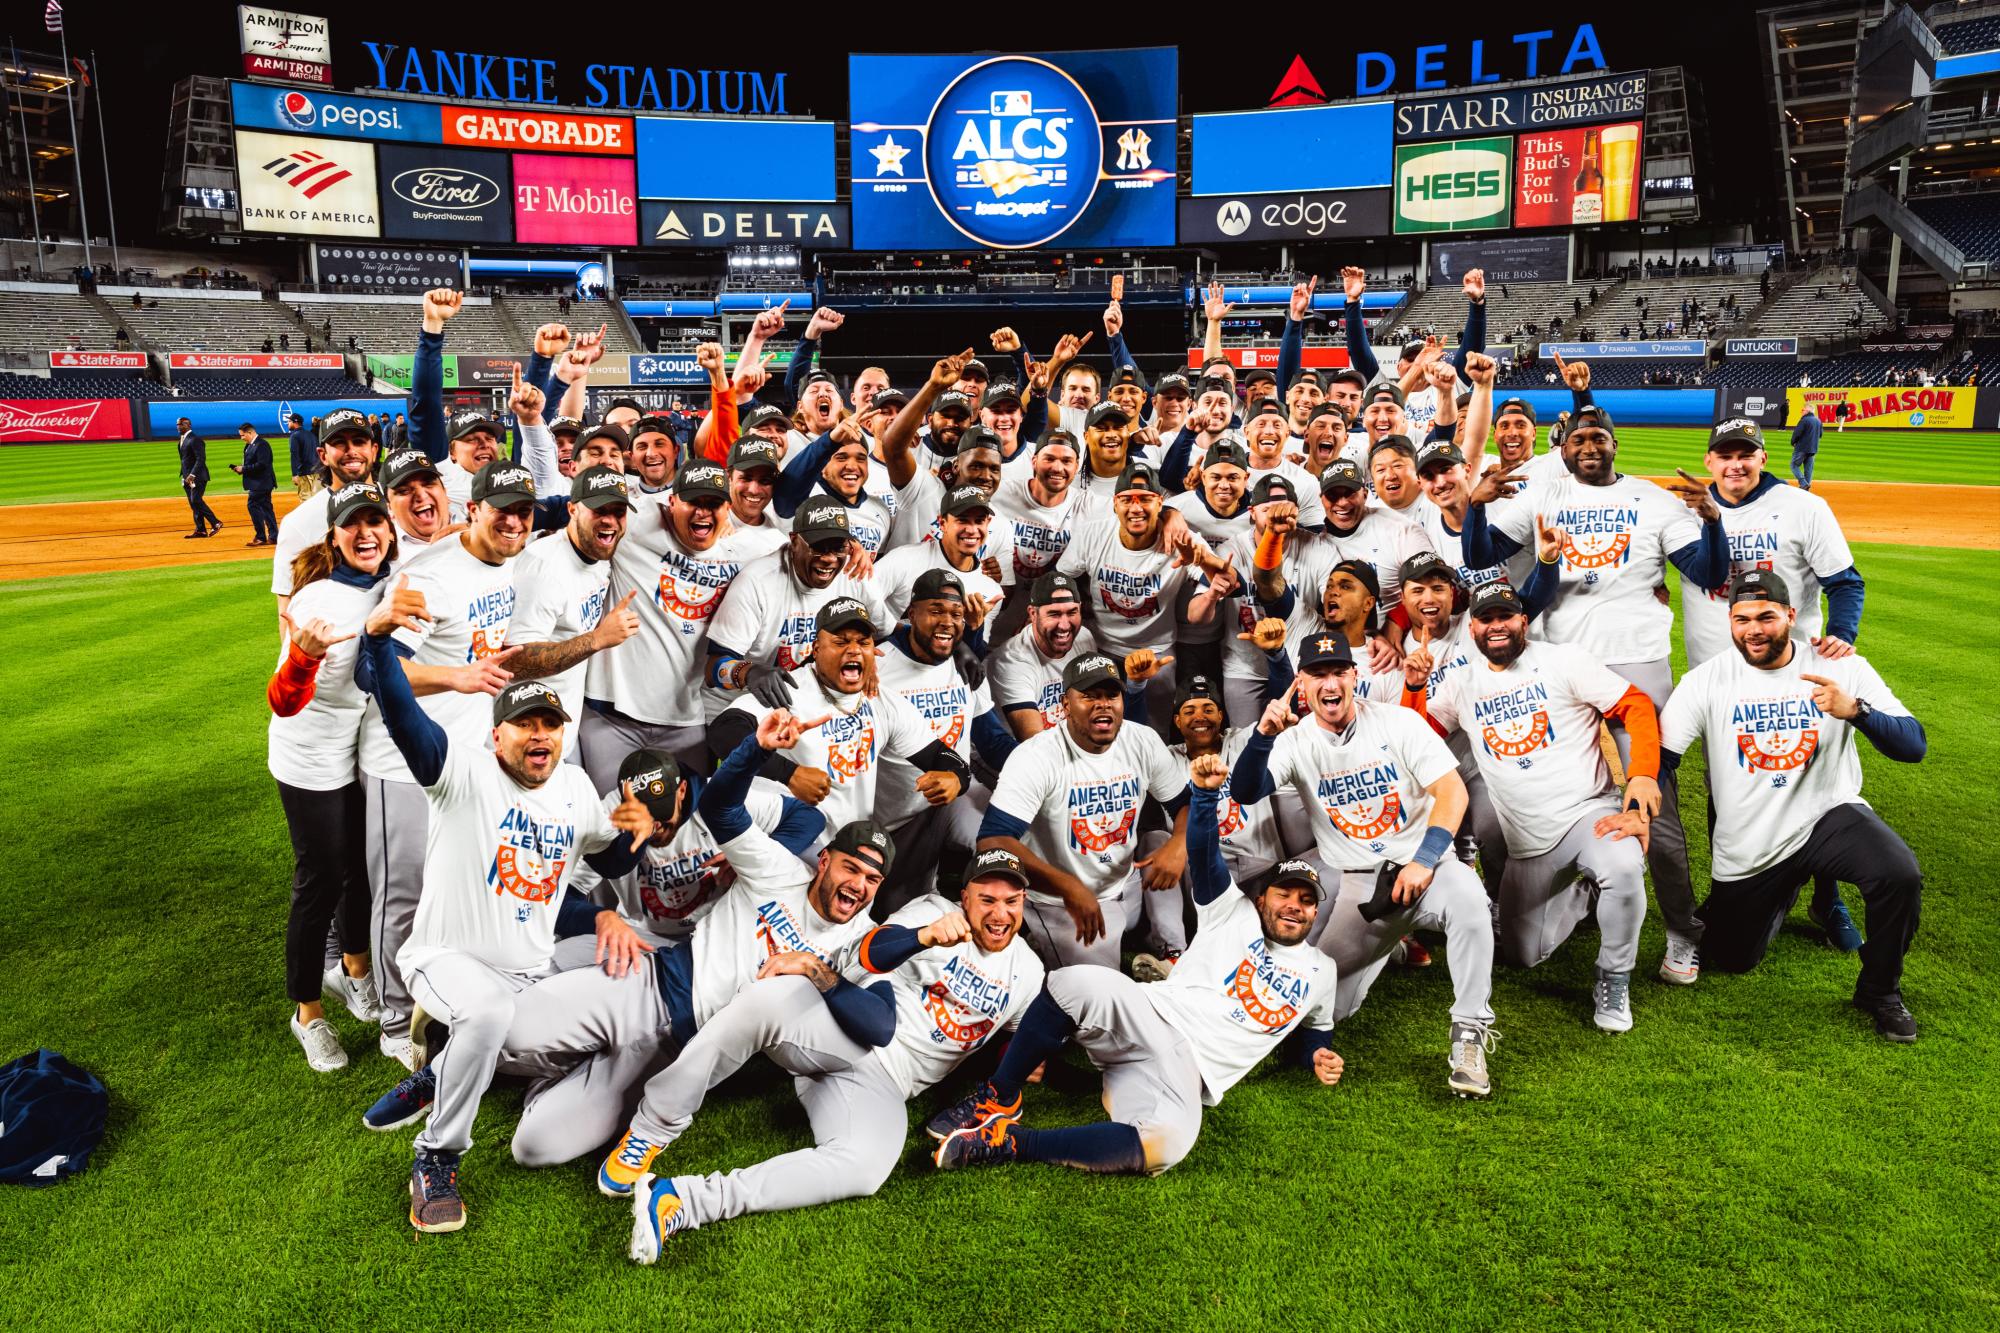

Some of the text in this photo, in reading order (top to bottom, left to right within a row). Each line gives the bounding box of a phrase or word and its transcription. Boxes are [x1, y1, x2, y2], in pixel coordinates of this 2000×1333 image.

[246, 14, 324, 34] ARMITRON
[253, 58, 323, 75] ARMITRON
[1356, 23, 1607, 96] DELTA
[289, 71, 323, 81] WATCHES
[362, 41, 789, 114] YANKEE STADIUM
[1531, 78, 1646, 108] INSURANCE
[322, 103, 399, 131] pepsi
[1396, 97, 1517, 135] STARR
[1530, 95, 1645, 123] COMPANIES
[456, 114, 623, 148] GATORADE
[952, 118, 1068, 160] ALCS
[1523, 138, 1563, 155] This
[1523, 153, 1571, 171] Bud's
[410, 171, 481, 204] Ford
[1406, 169, 1500, 202] HESS
[1523, 173, 1552, 188] For
[1522, 190, 1559, 205] You.
[245, 207, 376, 225] BANK OF AMERICA
[412, 211, 484, 222] BuyFordNow.com
[703, 213, 838, 238] DELTA
[1261, 198, 1348, 236] edge
[360, 261, 421, 275] New York Yankees
[1491, 270, 1539, 280] THE BOSS
[683, 328, 717, 336] TERRACE
[1732, 342, 1782, 352] UNTUCKit
[658, 359, 703, 375] coupa
[1732, 402, 1743, 410] THE
[1765, 403, 1777, 411] APP
[1804, 391, 1848, 402] WHO BUT
[1556, 509, 1638, 526] AMERICAN
[1565, 523, 1626, 536] LEAGUE
[1098, 568, 1162, 591] AMERICAN
[1105, 584, 1151, 598] LEAGUE
[1474, 682, 1549, 720] AMERICAN
[1732, 700, 1823, 725] AMERICAN
[1485, 703, 1539, 726] LEAGUE
[1745, 717, 1812, 734] LEAGUE
[1485, 713, 1547, 755] CHAMPIONS
[1741, 732, 1817, 769] CHAMPIONS
[1317, 761, 1399, 799] AMERICAN
[1067, 777, 1140, 809] AMERICAN
[1328, 784, 1390, 808] LEAGUE
[1079, 799, 1132, 818] LEAGUE
[1328, 796, 1397, 838] CHAMPIONS
[1074, 809, 1135, 850] CHAMPIONS
[943, 955, 1011, 1018] AMERICAN
[946, 976, 998, 1020] LEAGUE
[1237, 964, 1294, 1026] CHAMPIONS
